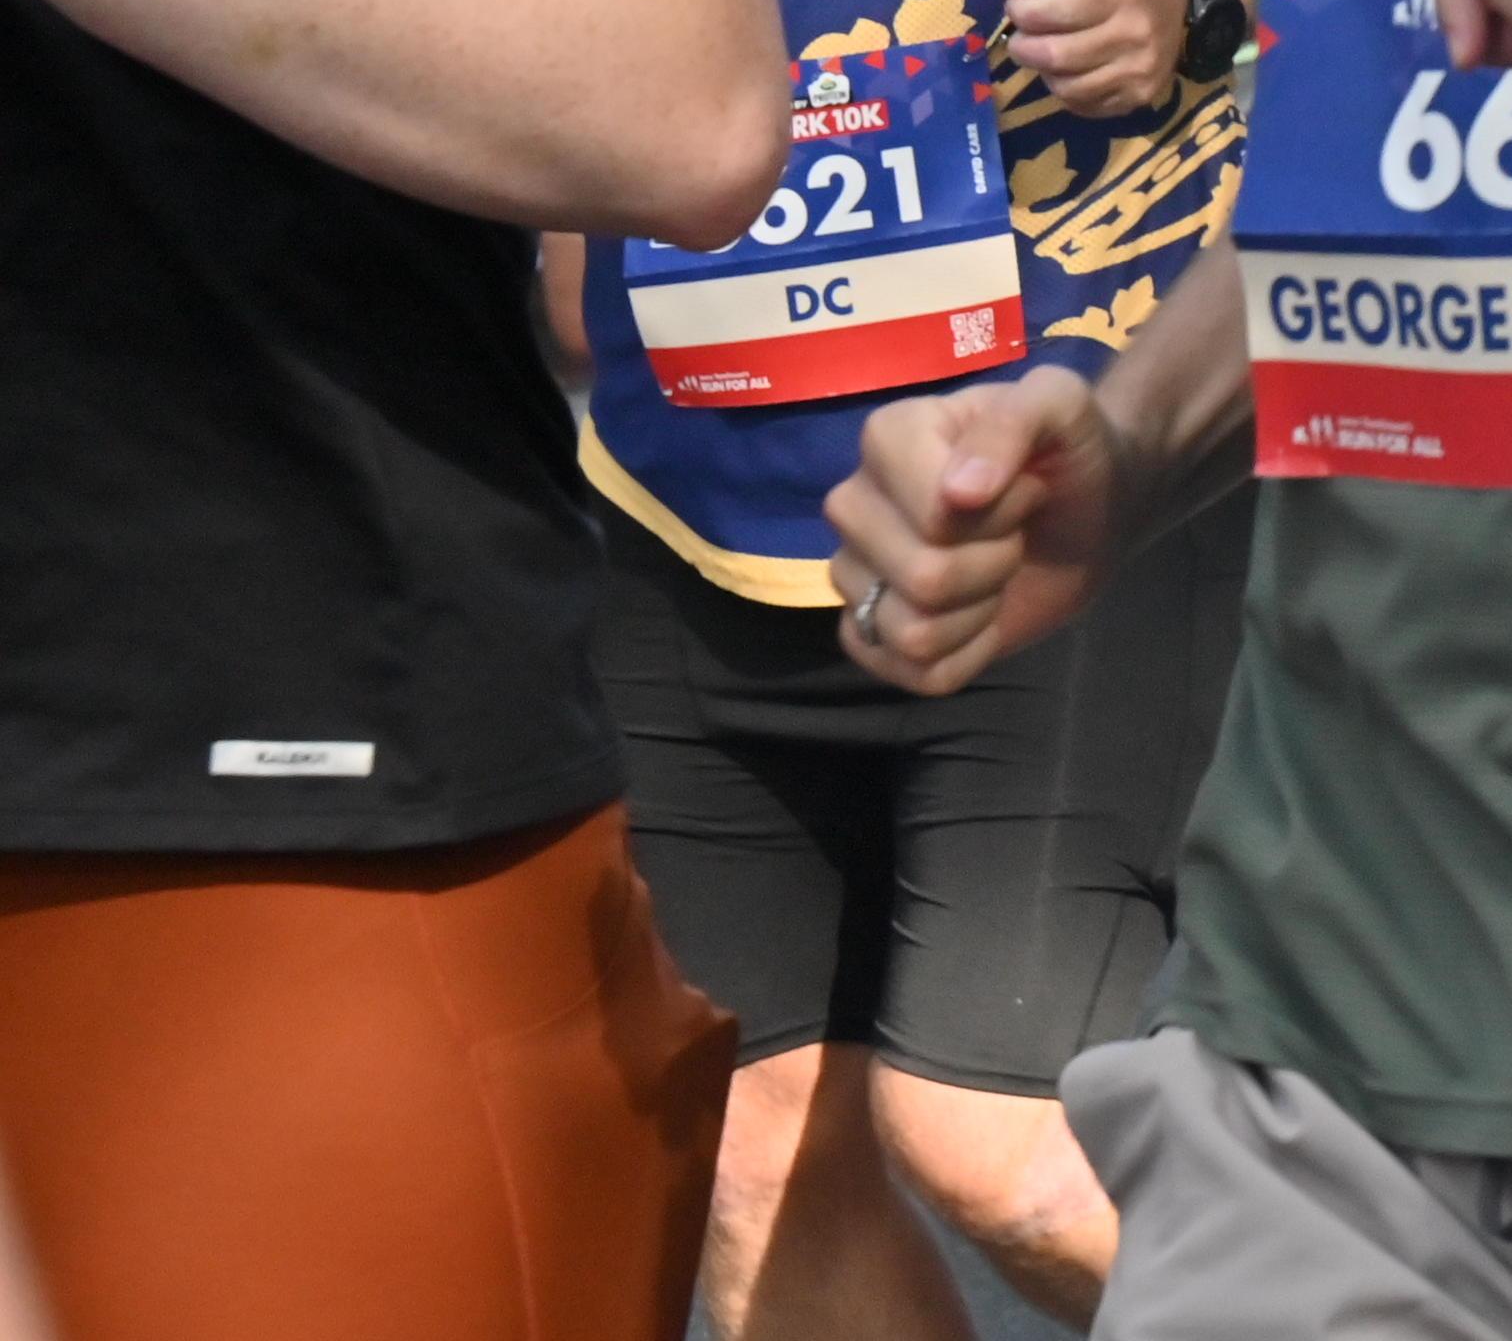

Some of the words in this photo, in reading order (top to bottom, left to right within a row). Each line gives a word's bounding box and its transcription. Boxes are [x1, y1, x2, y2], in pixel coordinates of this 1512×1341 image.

[792, 111, 831, 139] RK
[832, 102, 885, 133] 10K
[707, 146, 923, 254] 621
[785, 277, 854, 323] DC
[1270, 275, 1511, 352] GEORGE
